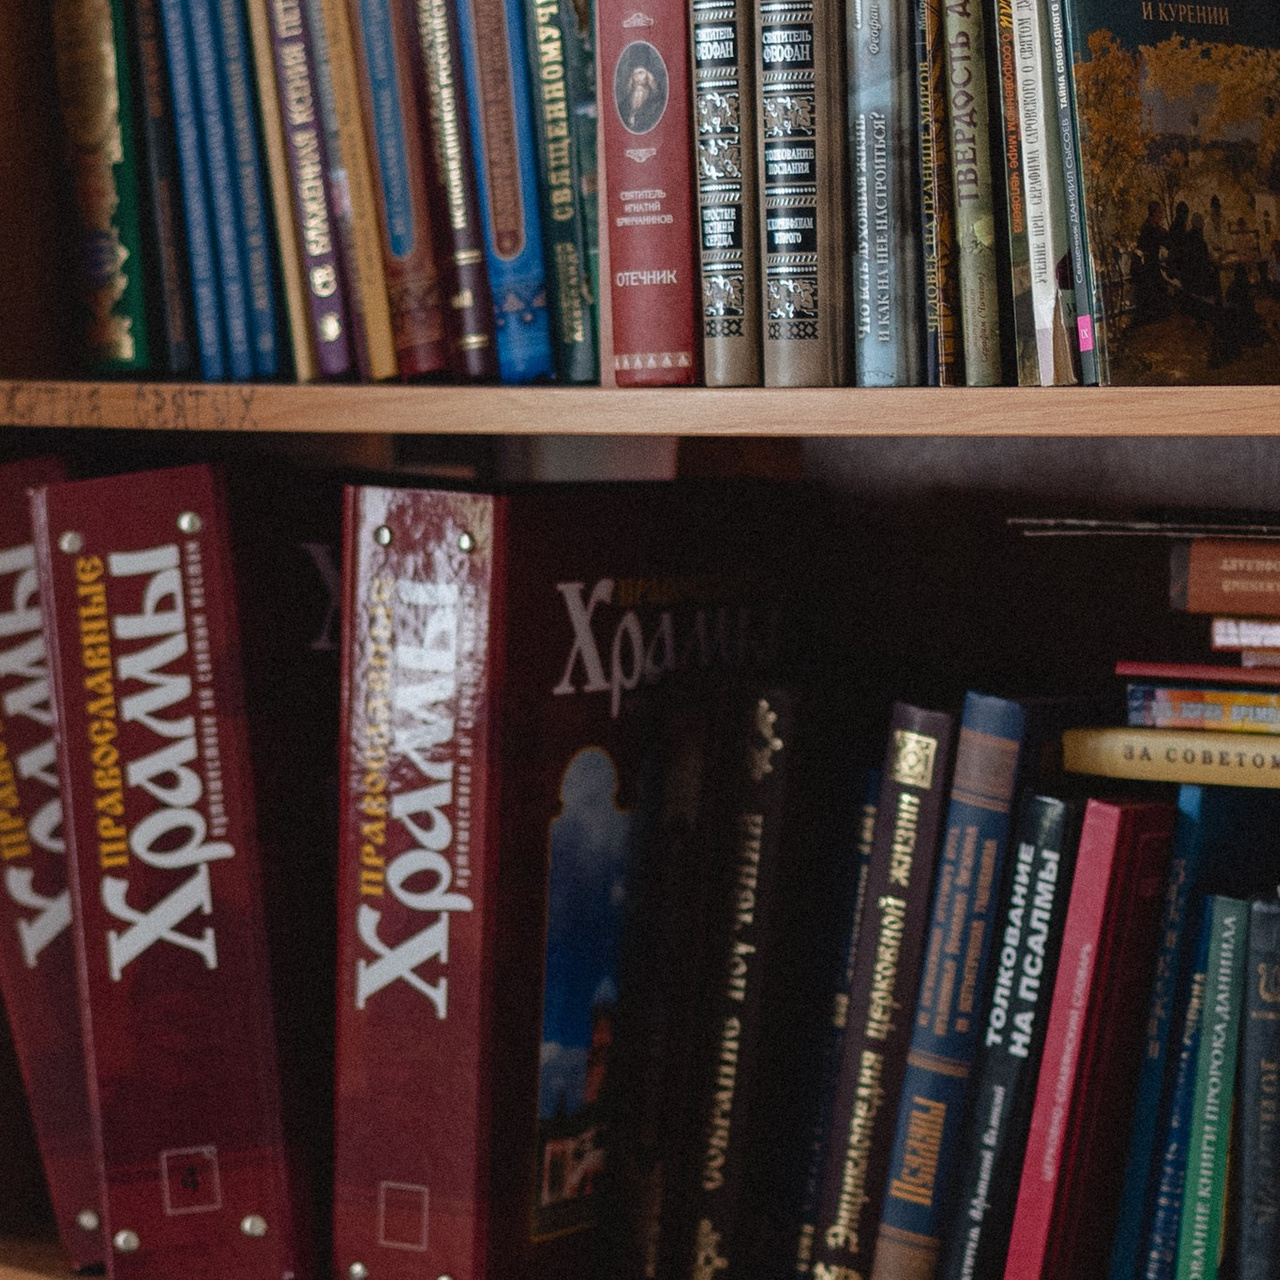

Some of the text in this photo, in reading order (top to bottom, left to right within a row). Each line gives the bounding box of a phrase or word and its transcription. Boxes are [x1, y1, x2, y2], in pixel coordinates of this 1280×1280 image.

[1051, 2, 1067, 73] СВОБОДНОГО
[1141, 1, 1230, 26] И КУРЕНИИ
[917, 62, 932, 125] МИРОВ
[946, 30, 979, 207] ТВЕРДОСТЬ
[869, 113, 888, 231] НАСТРОИТЬСЯ?
[616, 269, 679, 288] ОТЕЧНИК
[76, 556, 130, 868] ПРАВОСЛАВНЫЕ
[1123, 744, 1153, 762] ЗА
[862, 792, 919, 1038] церковной жизни
[984, 842, 1034, 1047] ТОЛКОВАНИЕ
[1009, 848, 1060, 1058] НА ПСАЛМЫ
[1203, 915, 1238, 1122] ПРОРОКА ДАНИИЛА
